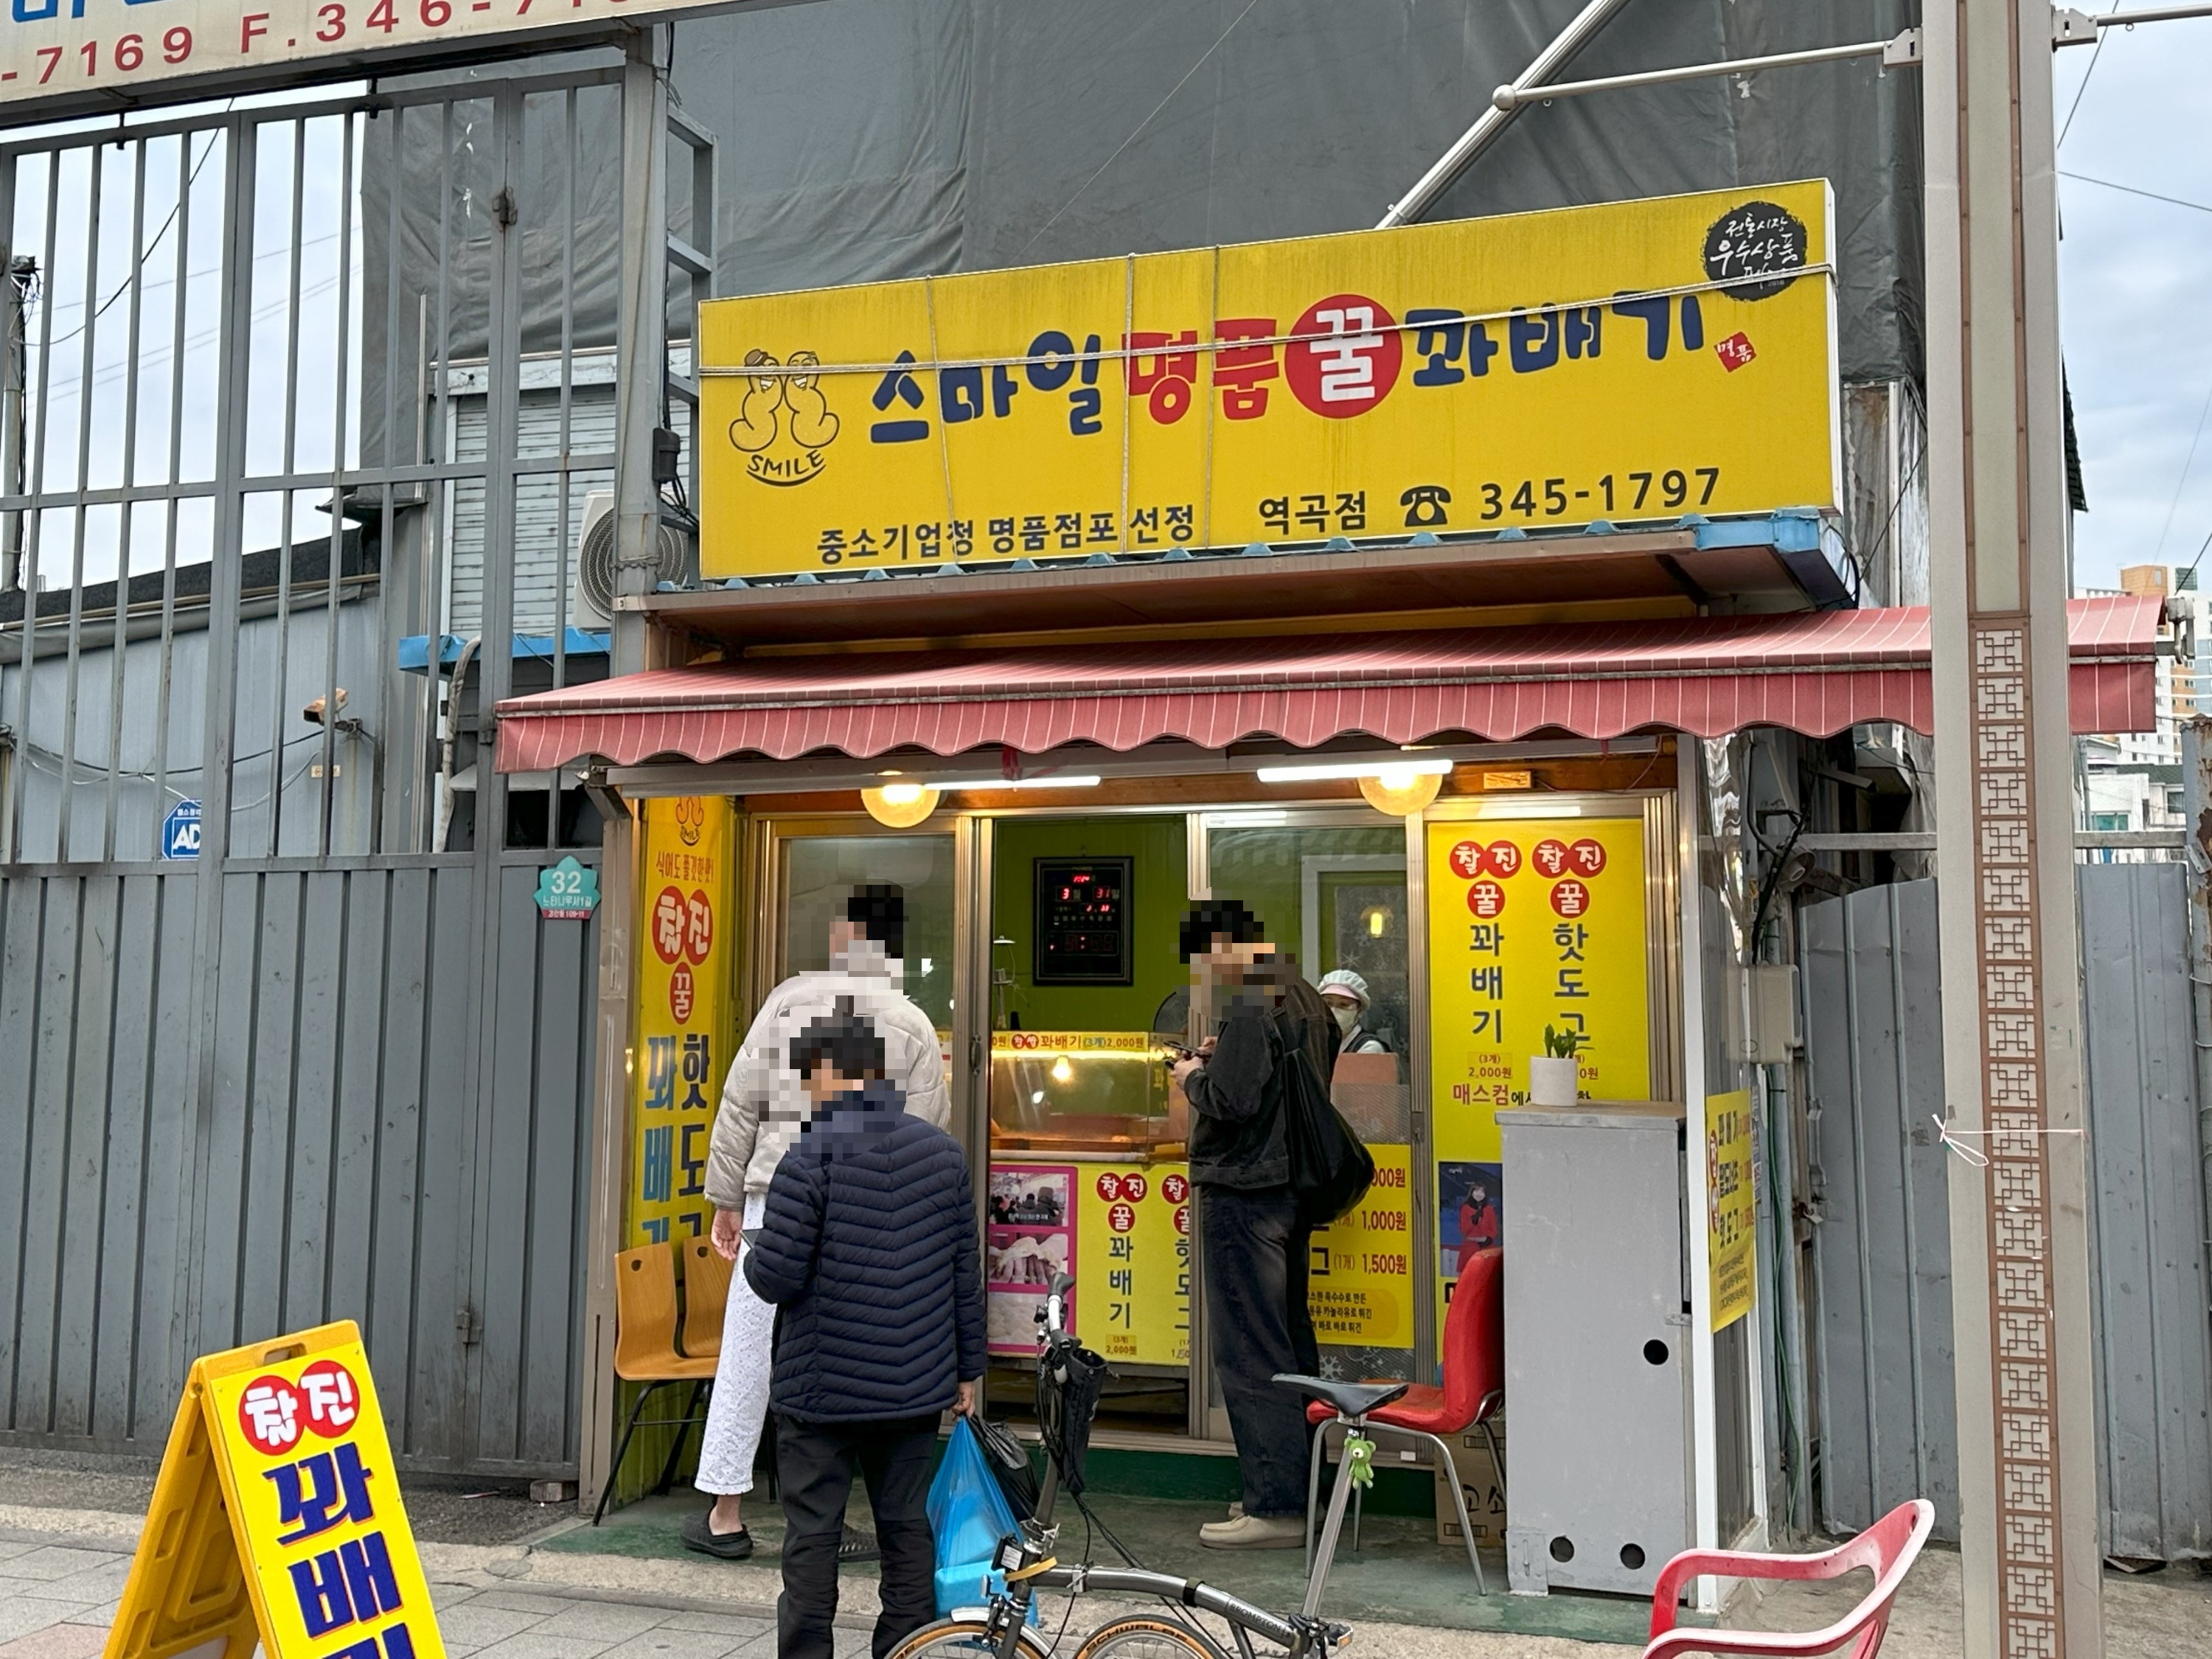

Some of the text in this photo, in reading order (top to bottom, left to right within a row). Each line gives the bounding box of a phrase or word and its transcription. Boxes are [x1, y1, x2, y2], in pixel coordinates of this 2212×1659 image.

[1709, 233, 1798, 276] 우수상품
[870, 290, 1705, 444] 스마일 명품 꿀 꽈배기
[746, 450, 825, 478] SMILE
[1259, 467, 1721, 535] 역곡점 345-1797
[817, 504, 1194, 565] 중소기업청 명품점포 선정
[1455, 845, 1517, 875] 찰진
[1537, 843, 1601, 874] 찰진
[551, 871, 582, 894] 32
[1473, 883, 1500, 915] 꿀
[1557, 883, 1583, 915] 꿀
[674, 973, 692, 1020] 꿀
[1470, 922, 1504, 1043] 꽈배기
[1553, 923, 1590, 1042] 핫도그
[1040, 1034, 1082, 1049] 꽈배기
[1100, 1176, 1144, 1198] 찰진
[1113, 1206, 1131, 1230] 꿀
[1362, 1211, 1407, 1231] 1,000원
[1334, 1254, 1355, 1270] (1개)
[1362, 1253, 1407, 1275] 1,500원
[1108, 1236, 1134, 1329] 꽈배기
[245, 1371, 356, 1447] 찰진
[1229, 1603, 1281, 1632] BROMPTON
